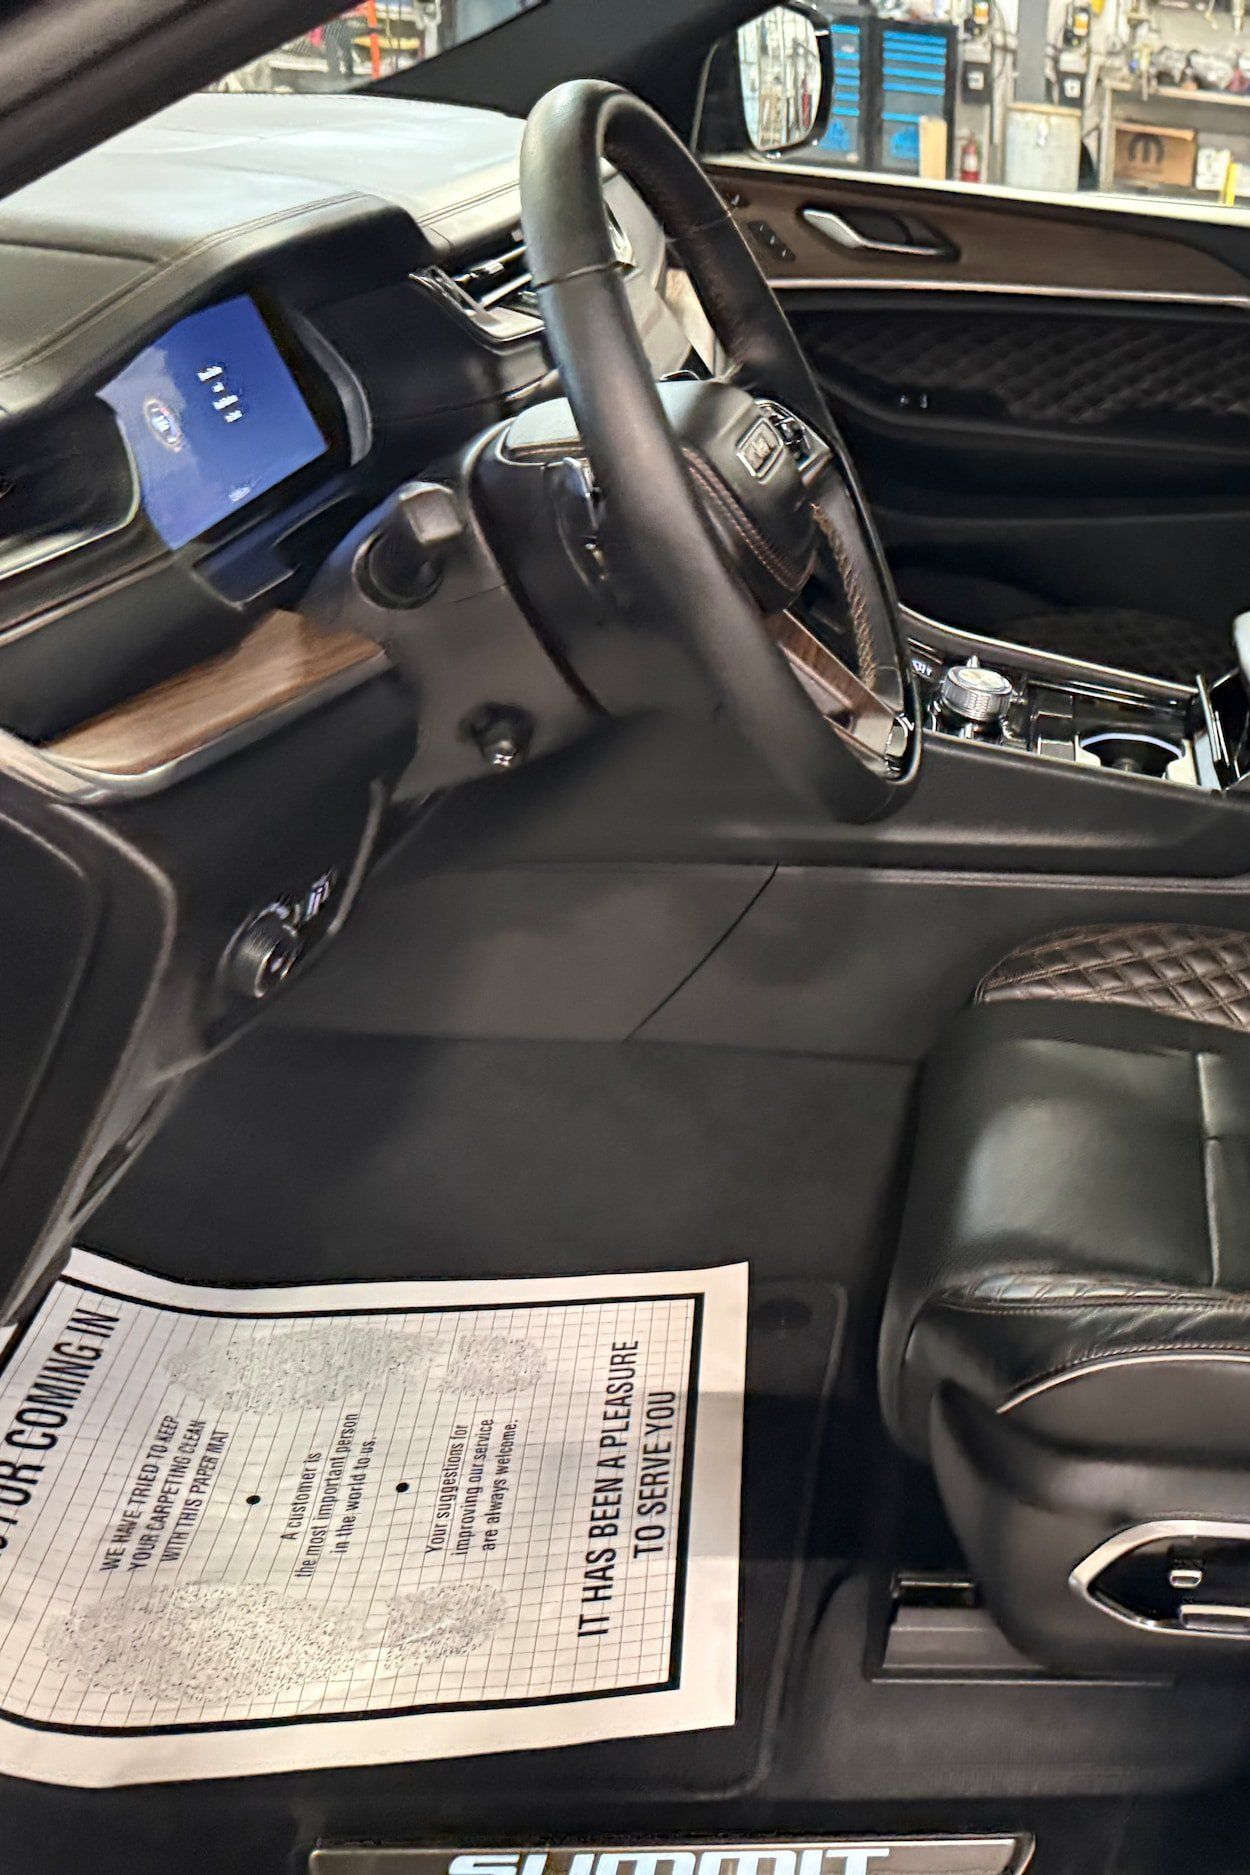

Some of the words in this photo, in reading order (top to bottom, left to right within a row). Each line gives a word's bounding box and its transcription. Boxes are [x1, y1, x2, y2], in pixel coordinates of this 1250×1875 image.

[5, 1342, 104, 1451] COMING
[67, 1308, 120, 1338] IN
[599, 1340, 640, 1449] PLEASURE
[155, 1415, 180, 1443] KEEP
[645, 1390, 677, 1439] YOU
[206, 1430, 229, 1453] MAT
[335, 1413, 359, 1454] person
[450, 1424, 469, 1440] for
[474, 1419, 494, 1462] service
[494, 1419, 519, 1477] welcome.
[146, 1444, 168, 1460] TO
[303, 1452, 322, 1464] is
[353, 1456, 371, 1470] to
[597, 1454, 626, 1469] A
[127, 1464, 160, 1506] TRIED
[189, 1455, 219, 1494] PAPER
[313, 1457, 347, 1521] important
[437, 1444, 464, 1519] suggestions
[469, 1463, 485, 1484] our
[636, 1440, 673, 1517] SERVE
[127, 1534, 159, 1571] YOUR
[146, 1455, 192, 1531] CARPETING
[178, 1419, 207, 1454] CLEAN
[287, 1468, 317, 1528] customer
[346, 1473, 368, 1512] world
[484, 1479, 510, 1524] always
[588, 1478, 624, 1539] BEEN
[111, 1509, 142, 1543] HAVE
[177, 1499, 203, 1527] THIS
[335, 1516, 356, 1538] the
[450, 1486, 484, 1556] improving
[160, 1532, 190, 1562] WITH
[280, 1531, 299, 1540] A
[306, 1525, 328, 1557] most
[330, 1540, 350, 1553] in
[425, 1523, 448, 1554] Your
[482, 1529, 499, 1551] are
[633, 1523, 666, 1559] TO
[100, 1547, 126, 1571] WE
[294, 1559, 316, 1578] the
[581, 1548, 617, 1603] HAS
[577, 1613, 610, 1638] IT
